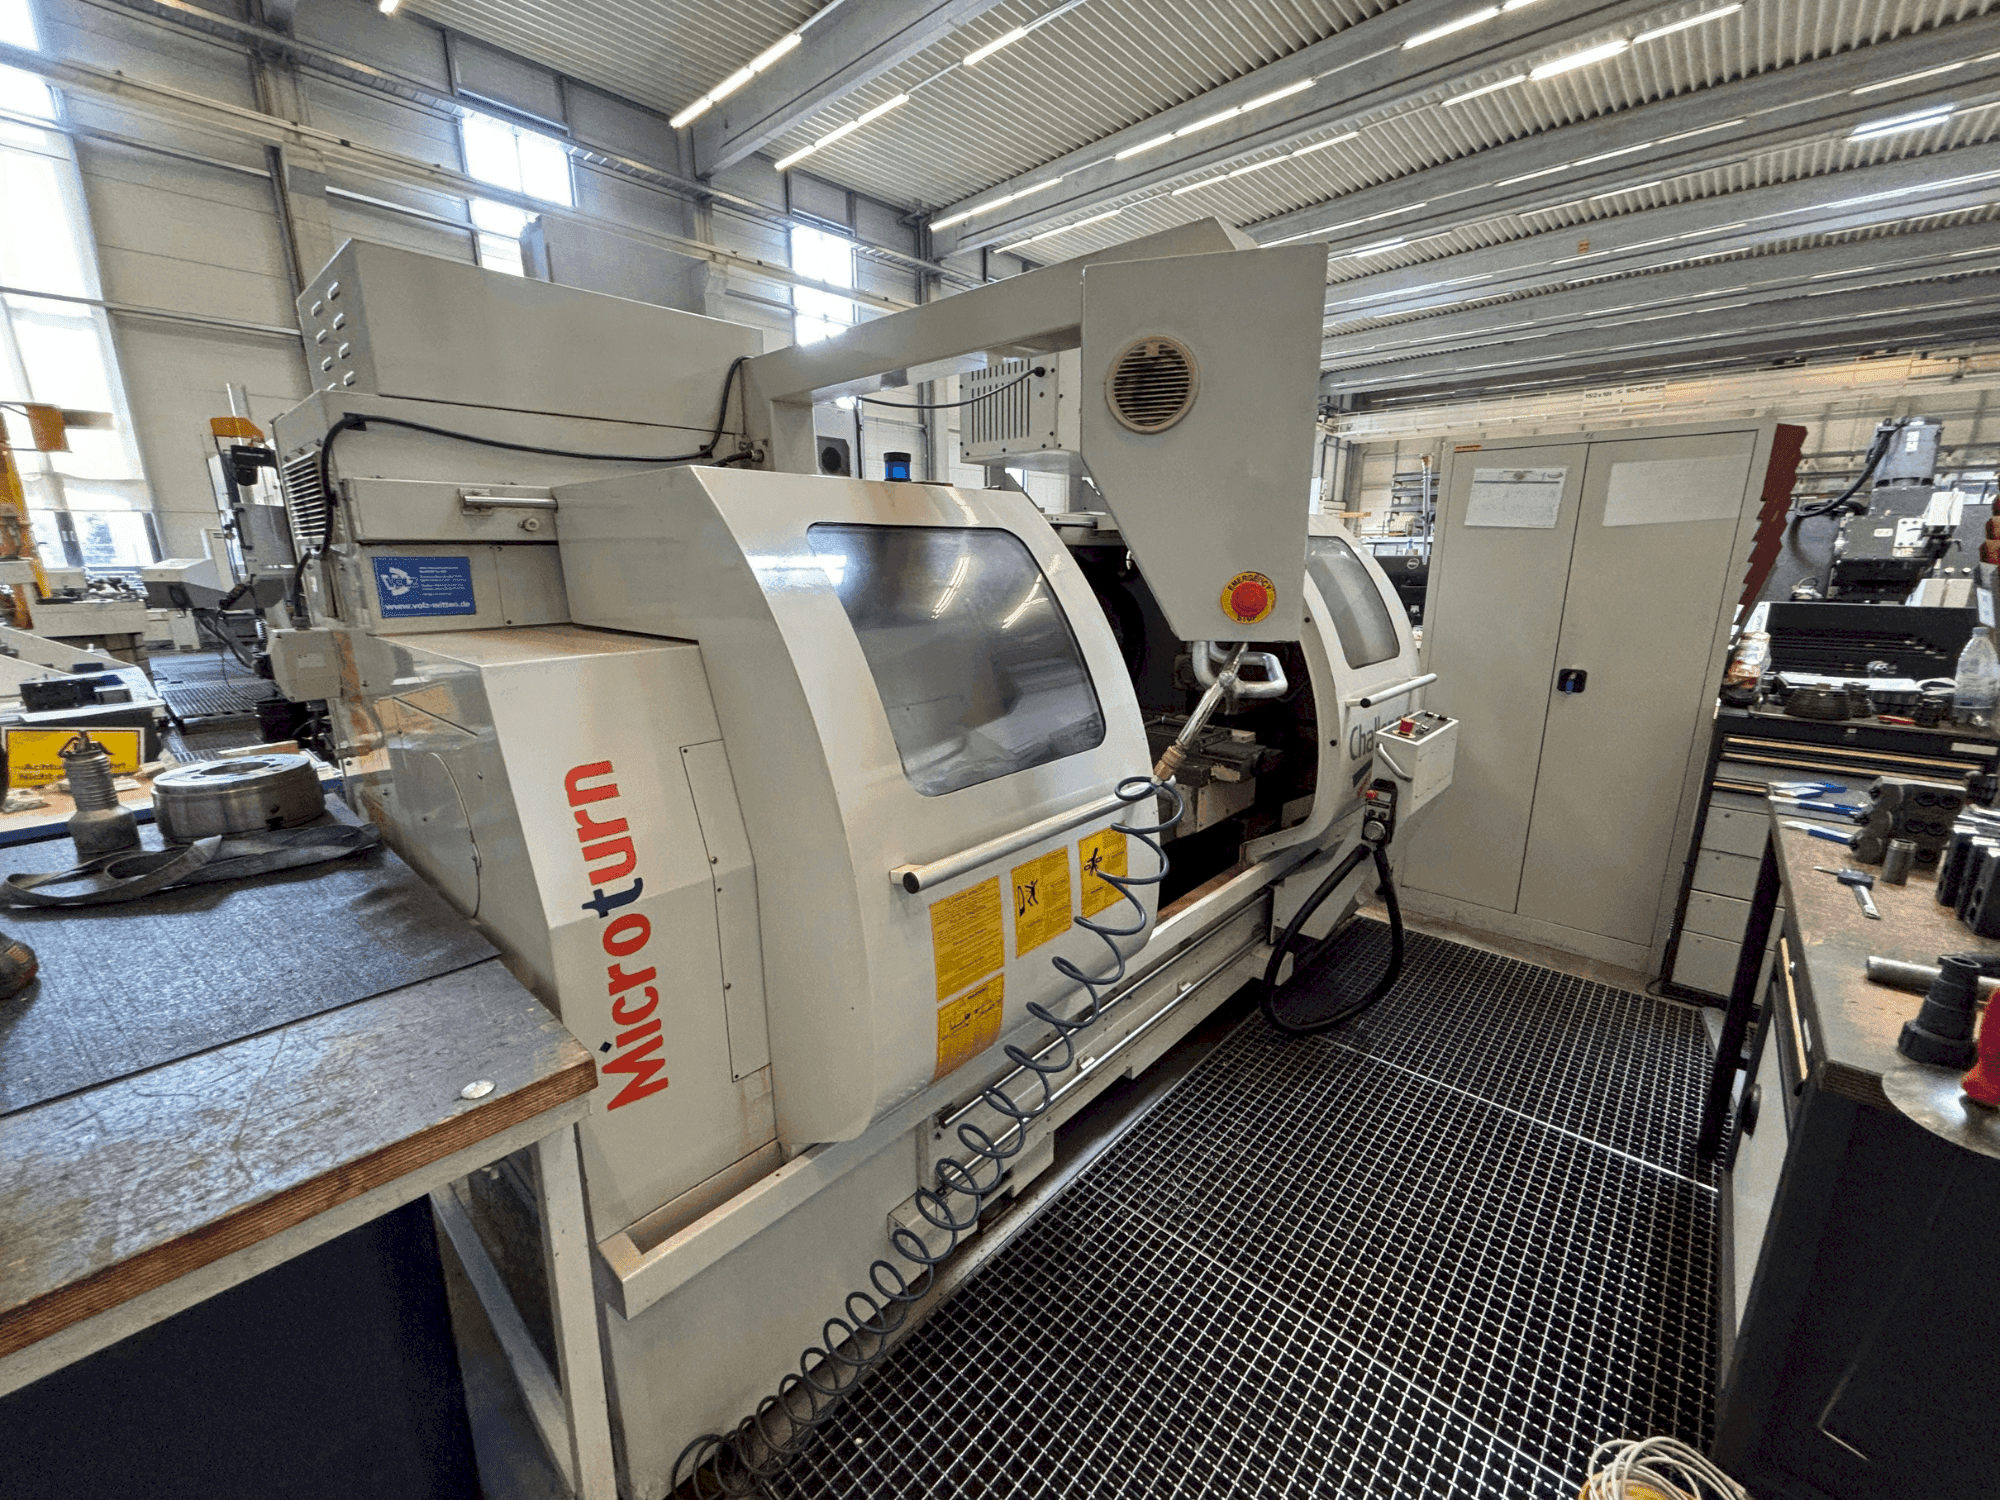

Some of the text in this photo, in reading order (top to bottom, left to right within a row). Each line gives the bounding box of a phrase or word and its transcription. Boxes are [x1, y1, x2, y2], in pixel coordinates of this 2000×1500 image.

[1227, 574, 1272, 591] EMERGENCY
[385, 602, 470, 610] www.volz-witten.de
[564, 759, 669, 1112] Microturn
